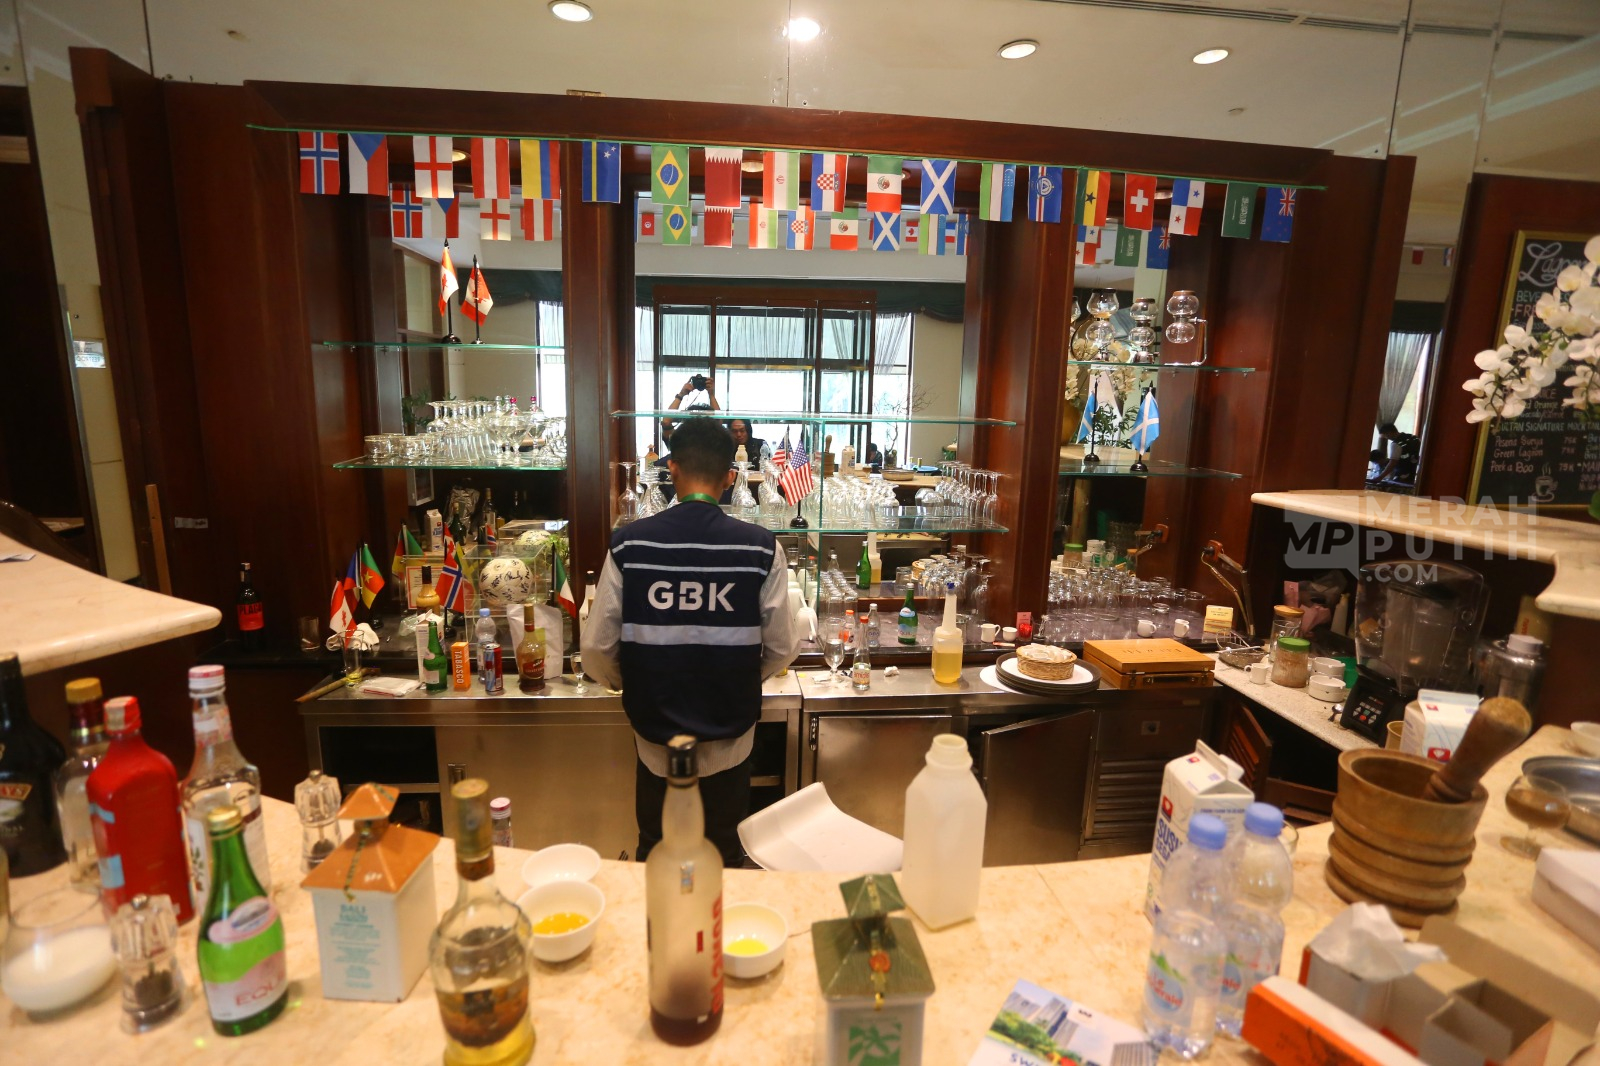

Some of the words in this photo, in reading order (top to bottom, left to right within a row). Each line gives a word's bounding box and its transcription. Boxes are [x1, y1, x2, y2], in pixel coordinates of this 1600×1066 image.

[1525, 421, 1564, 431] SIGNATURE
[1494, 449, 1515, 458] Green
[1515, 461, 1534, 473] Boo
[648, 580, 736, 612] GBK
[453, 650, 465, 685] TABASCO
